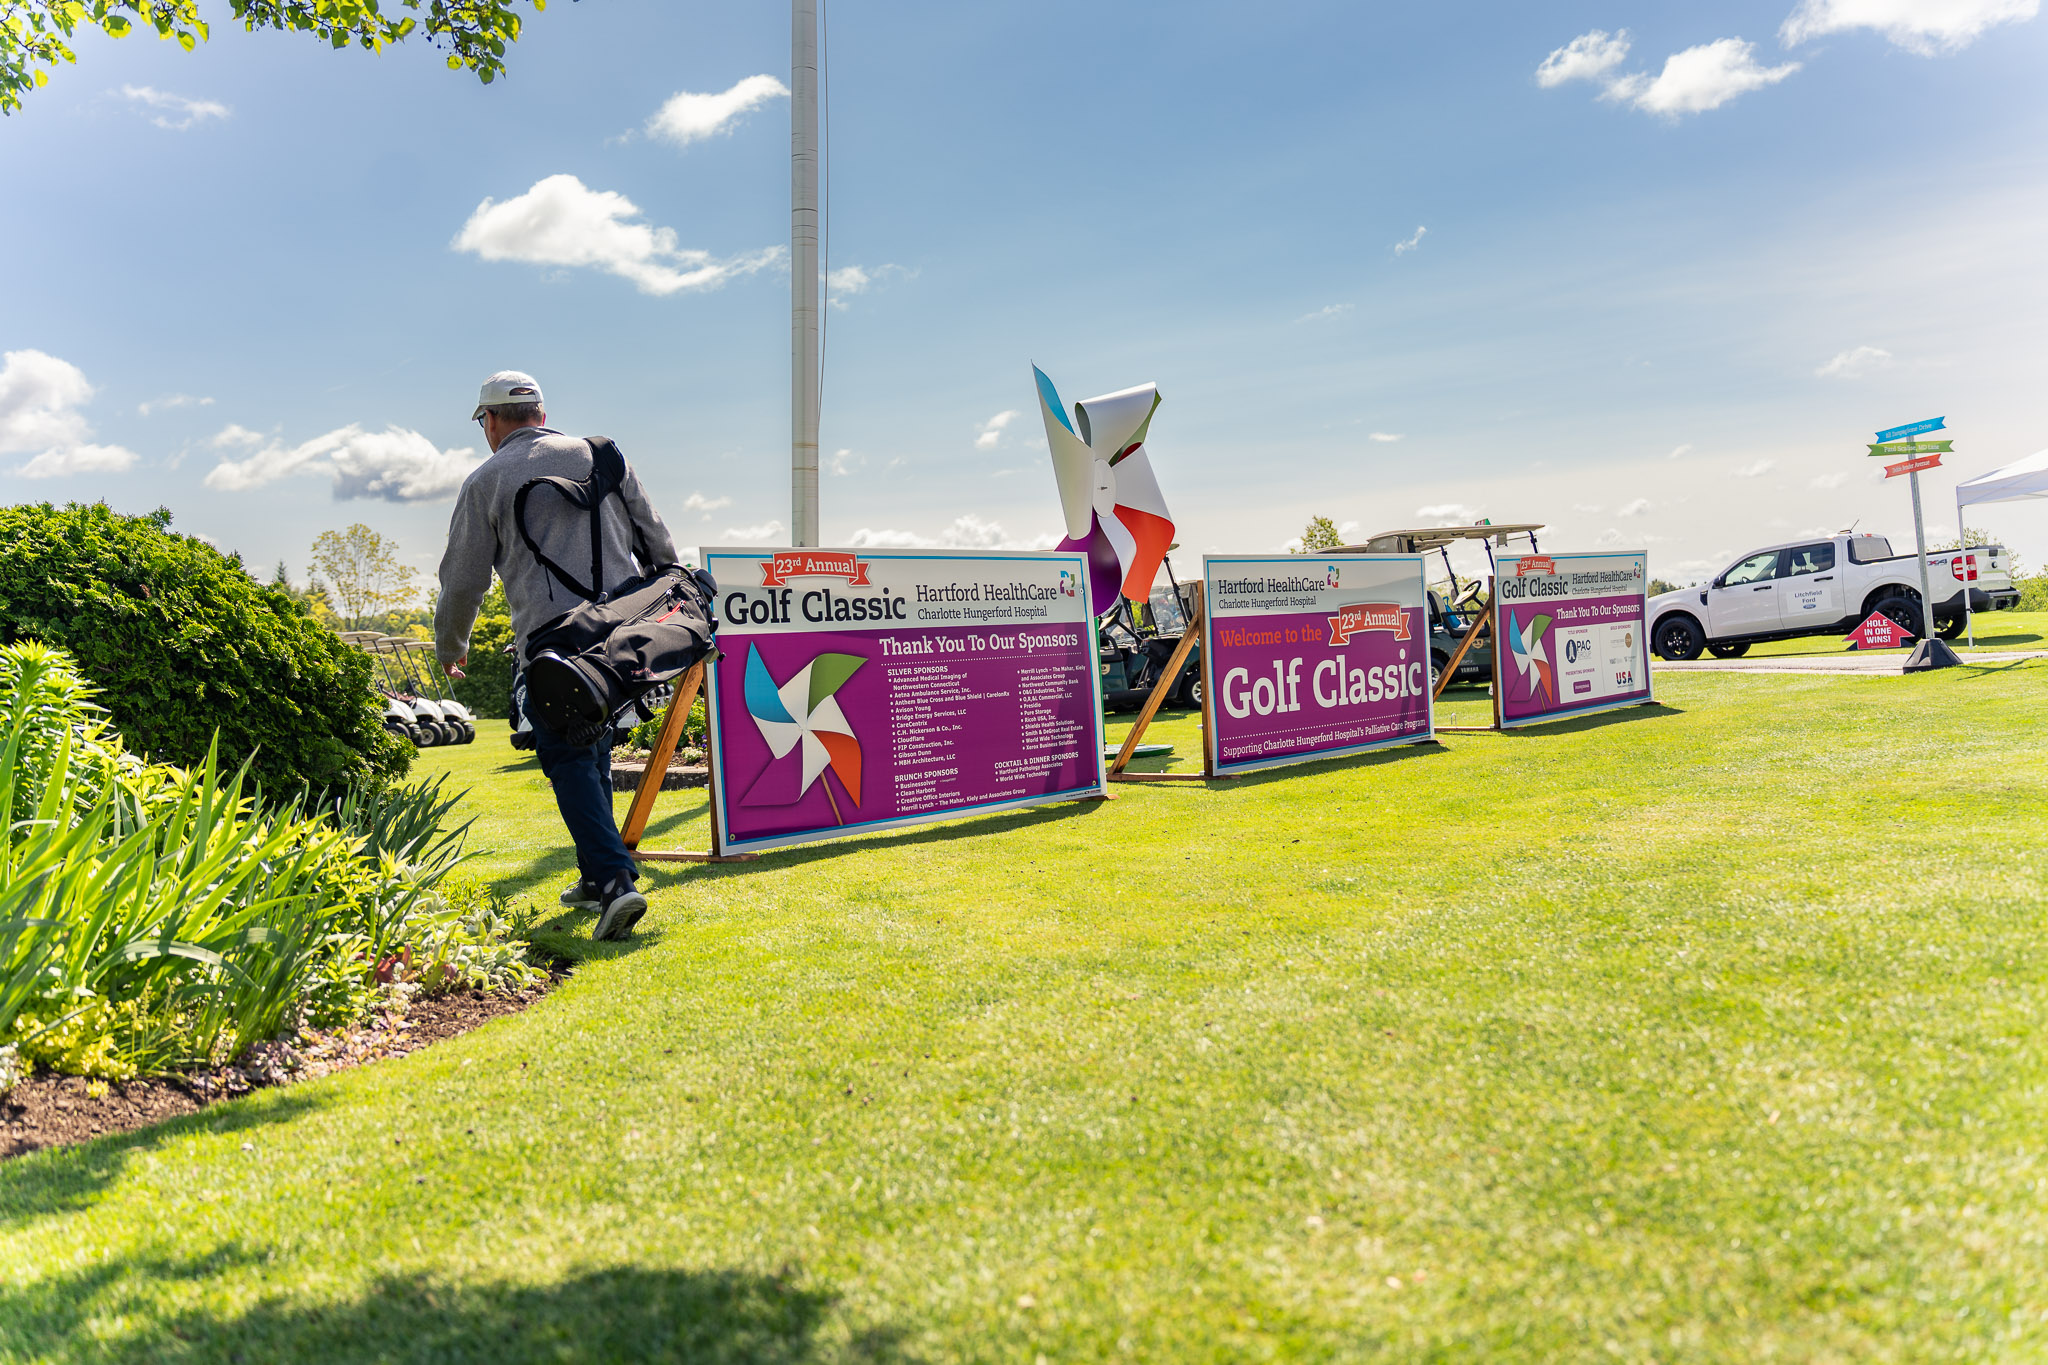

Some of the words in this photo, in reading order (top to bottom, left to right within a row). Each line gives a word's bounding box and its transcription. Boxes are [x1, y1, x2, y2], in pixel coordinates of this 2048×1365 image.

[776, 558, 801, 574] 23rd
[805, 558, 855, 573] Annual
[1521, 560, 1531, 569] 23rd
[1532, 560, 1551, 568] Annual
[1572, 571, 1598, 584] Hartford
[1600, 570, 1632, 583] HealthCare
[916, 583, 980, 602] Hartford
[984, 583, 1057, 601] HealthCare
[1218, 578, 1264, 594] Hartford
[1267, 577, 1324, 593] HealthCare
[1502, 577, 1526, 598] Golf
[1530, 576, 1568, 597] Classic
[1794, 590, 1822, 598] Litchfield
[724, 589, 792, 625] Golf
[802, 587, 906, 622] Classic
[1219, 599, 1249, 609] Charlotte
[1251, 598, 1288, 610] Hungerford
[1290, 596, 1316, 608] Hospital
[918, 608, 961, 620] Charlotte
[963, 606, 1012, 621] Hungerford
[1014, 606, 1047, 619] Hospital
[1557, 607, 1577, 619] Thank
[1578, 606, 1590, 617] You
[1591, 606, 1599, 616] To
[1600, 605, 1611, 615] Our
[1612, 604, 1640, 617] Sponsors
[1341, 611, 1361, 630] 23rd
[1364, 609, 1400, 626] Annual
[1866, 619, 1888, 627] HOLE
[1220, 627, 1282, 647] Welcome
[1286, 628, 1298, 642] to
[1301, 624, 1322, 642] the
[1866, 636, 1891, 644] WINS!
[879, 636, 933, 656] Thank
[935, 636, 964, 653] You
[968, 635, 986, 651] To
[989, 634, 1015, 650] Our
[1019, 632, 1078, 653] Sponsors
[1577, 640, 1591, 651] PAC
[888, 668, 912, 676] SILVER
[914, 666, 948, 674] SPONSORS
[1616, 671, 1633, 684] USA
[893, 682, 929, 690] Northwestern
[1222, 657, 1303, 719] Golf
[1312, 648, 1423, 708] Classic
[1223, 742, 1262, 758] Supporting
[1263, 738, 1295, 751] Charlotte
[1296, 734, 1333, 747] Hungerford
[1334, 729, 1364, 742] Hospital's
[1365, 724, 1390, 736] Palliative
[1391, 723, 1403, 731] Care
[1404, 719, 1426, 730] Program
[912, 756, 946, 764] Architecture,
[995, 760, 1022, 769] COCKTAIL
[1030, 756, 1050, 764] DINNER
[1051, 752, 1078, 762] SPONSORS
[895, 772, 922, 782] BRUNCH
[924, 768, 958, 778] SPONSORS
[999, 767, 1018, 775] Hartford
[900, 780, 936, 789] Businessolver
